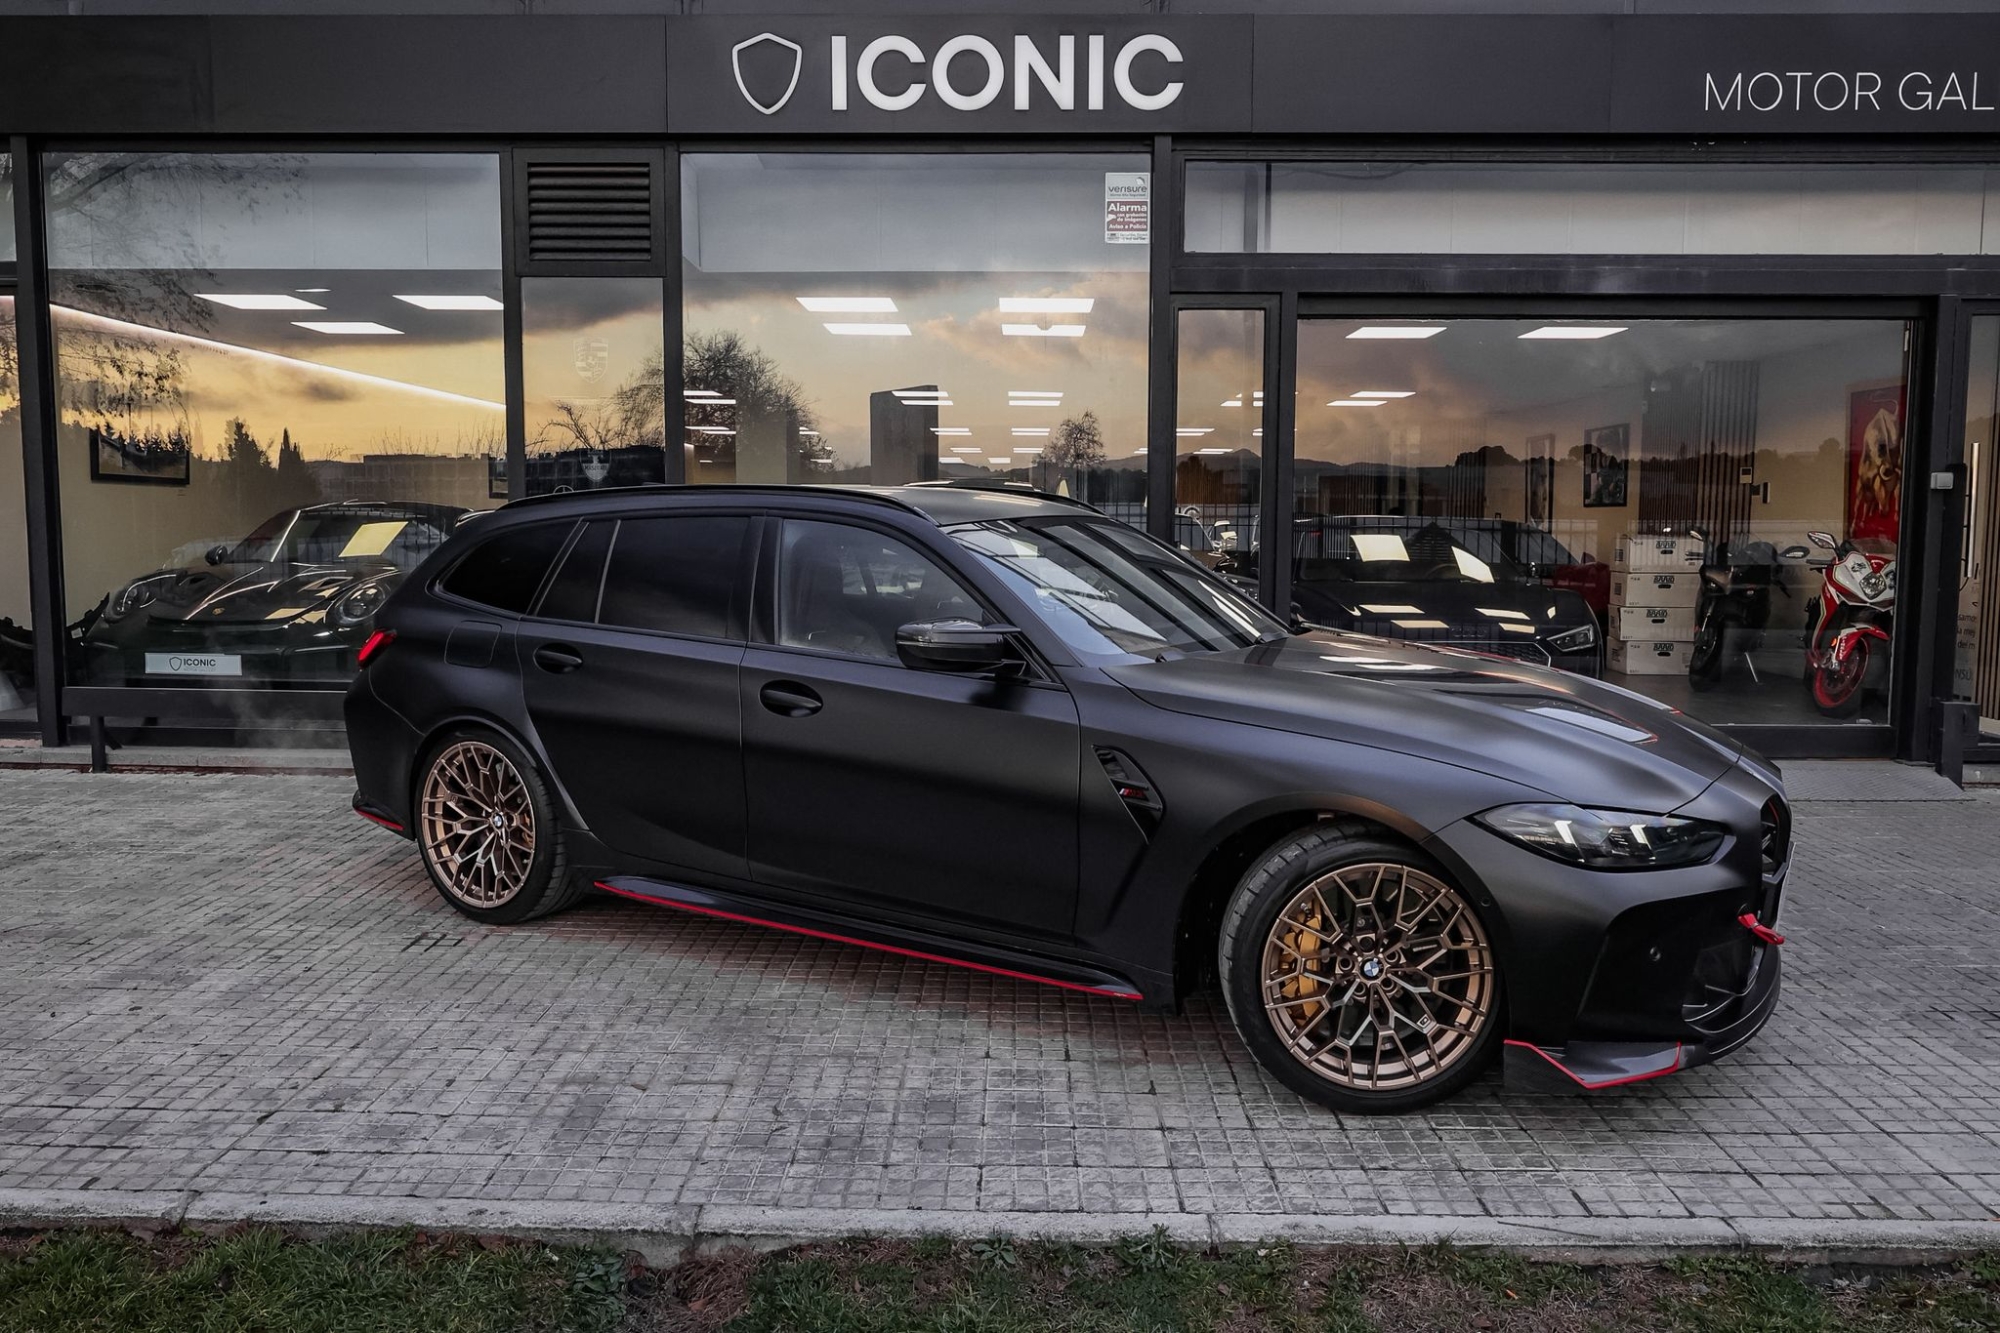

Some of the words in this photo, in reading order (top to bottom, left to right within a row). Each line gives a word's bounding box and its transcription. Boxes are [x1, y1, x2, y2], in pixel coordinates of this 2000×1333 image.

[831, 34, 1184, 111] ICONIC
[1705, 72, 1881, 111] MOTOR
[1898, 72, 1995, 111] GAL
[1108, 203, 1147, 212] Alarma
[183, 658, 216, 667] ICONIC
